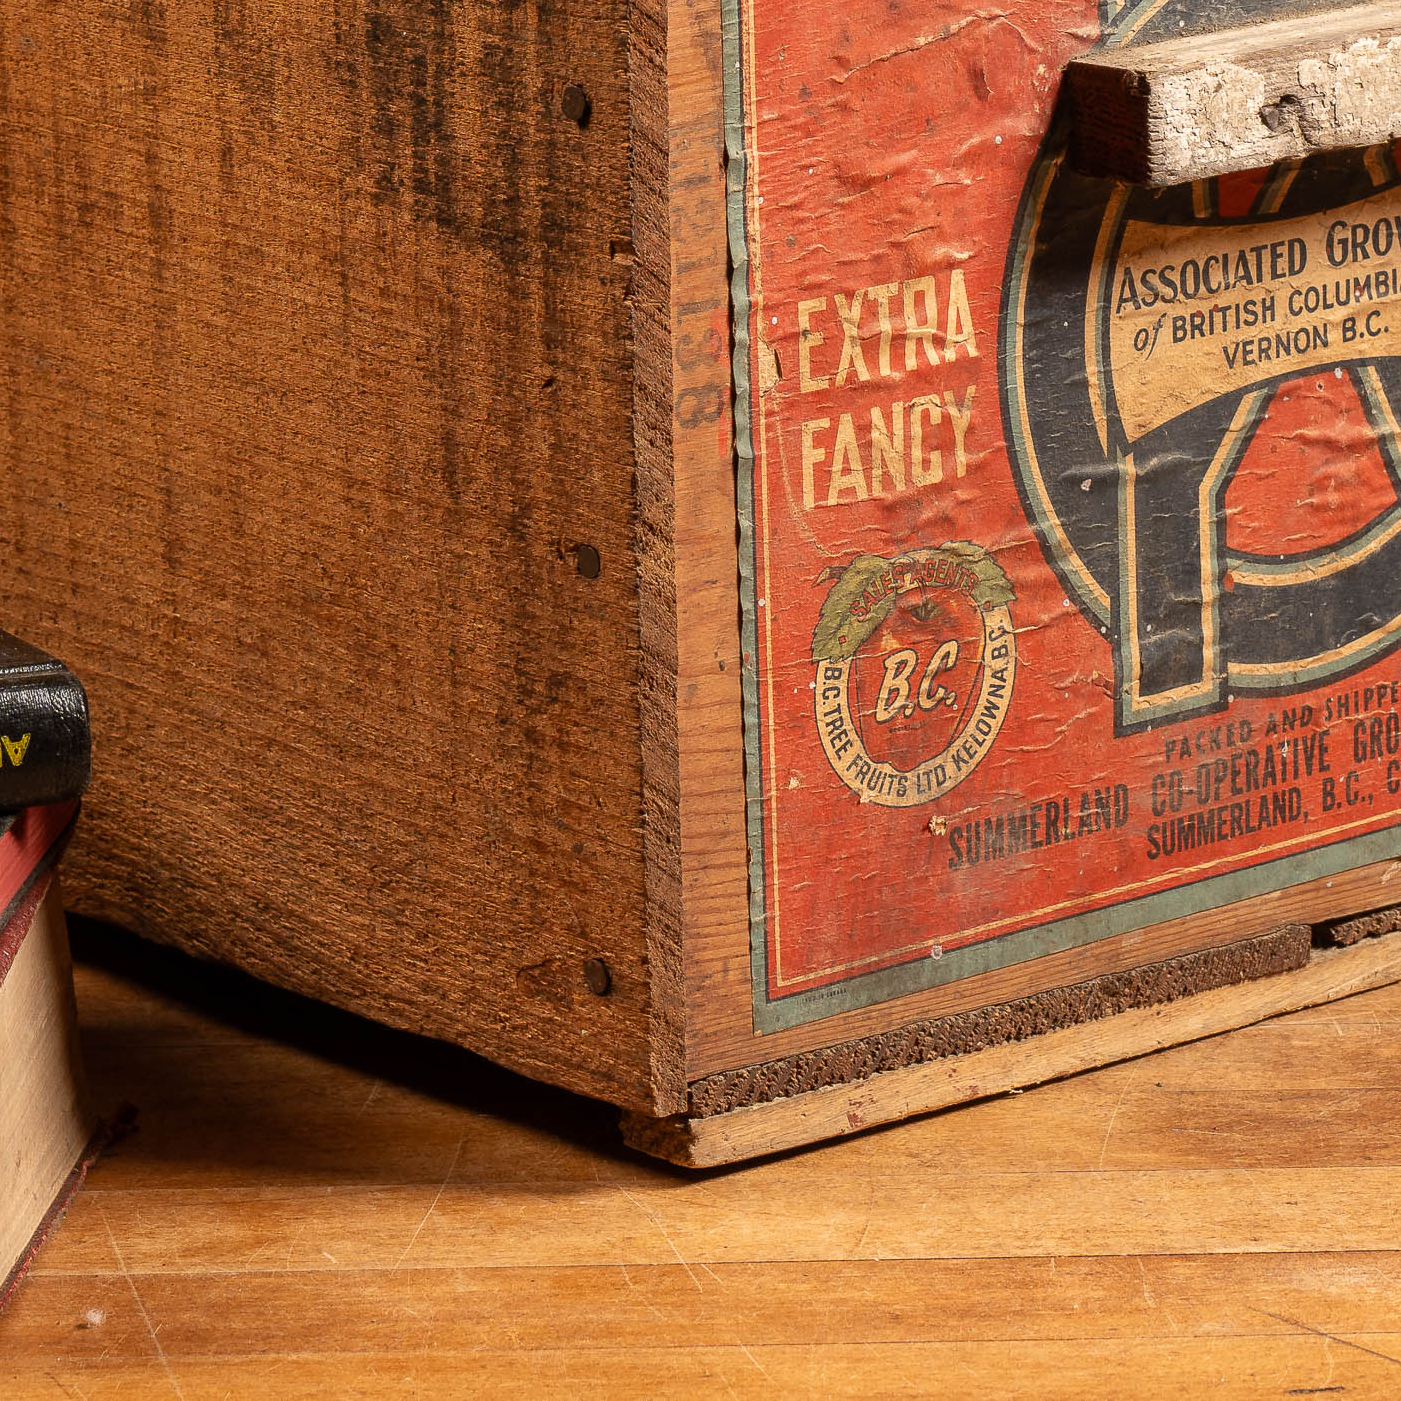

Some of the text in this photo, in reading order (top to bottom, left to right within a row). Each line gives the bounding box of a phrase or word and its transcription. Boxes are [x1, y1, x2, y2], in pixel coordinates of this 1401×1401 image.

[1115, 236, 1308, 315] ASSOCIATED
[797, 268, 980, 394] EXTRA
[1133, 311, 1169, 361] of
[1171, 295, 1276, 344] BRITISH
[1221, 309, 1390, 370] VERNON B.C.
[801, 384, 977, 512] FANCY
[821, 666, 842, 706] B.C.
[875, 638, 960, 725] B.C.
[822, 705, 854, 761] TREE
[951, 666, 1008, 773] KELOWNA
[1165, 718, 1252, 764] PACKED
[1265, 703, 1314, 736] AND
[845, 753, 909, 798] FRUITS
[916, 761, 953, 795] LTD.
[947, 782, 1131, 872] SUMMERLAND
[1150, 729, 1331, 819] CO-OPERATIVE
[1145, 785, 1309, 861] SUMMERLAND,
[1321, 770, 1374, 813] B.C.,
